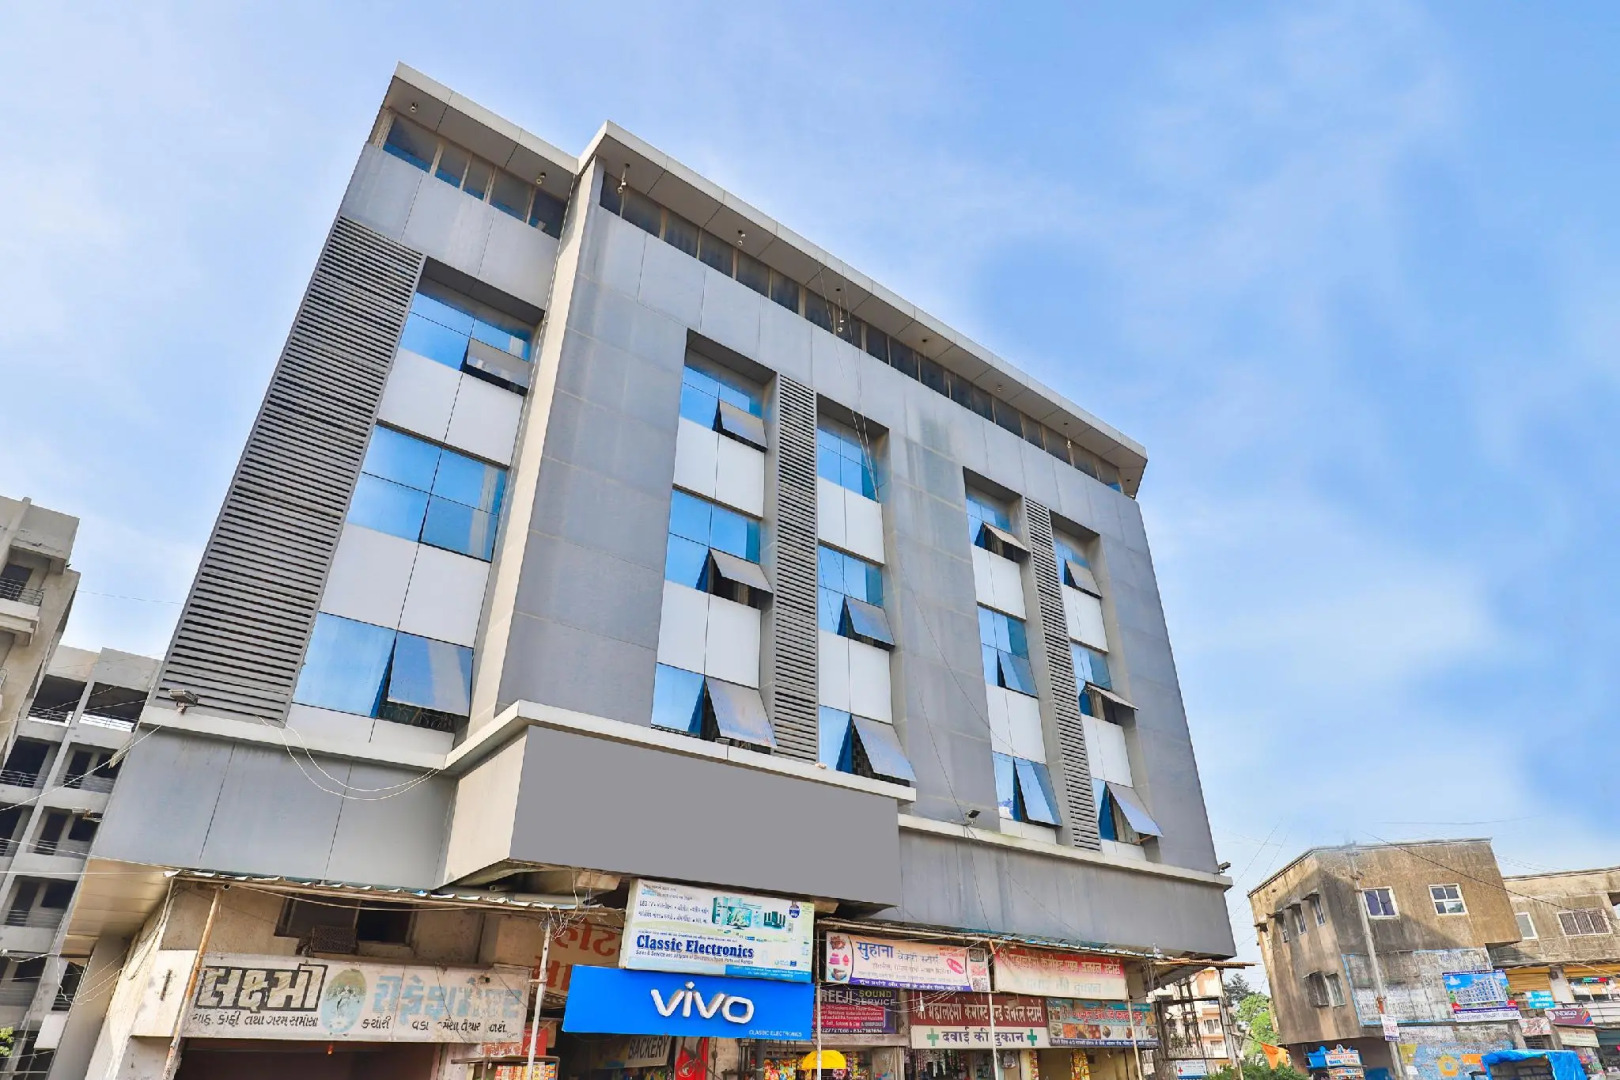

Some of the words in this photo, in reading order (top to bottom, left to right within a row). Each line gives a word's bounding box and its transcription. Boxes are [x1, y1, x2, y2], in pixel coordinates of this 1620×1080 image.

[636, 934, 683, 952] Classic
[685, 939, 755, 959] Electronics
[856, 941, 894, 961] सुहाना
[195, 963, 328, 1013] લક્ષ્મી
[820, 989, 853, 1004] REEJI
[860, 989, 892, 998] SOUND
[650, 981, 755, 1024] vivo
[855, 998, 897, 1006] SERVICE
[244, 1014, 264, 1026] તથા
[266, 1015, 288, 1027] ગરમ
[411, 1020, 429, 1032] વડા
[749, 1029, 769, 1037] CLASSIC
[941, 1026, 970, 1044] दवाई
[973, 1027, 990, 1043] की
[993, 1032, 1025, 1047] दुकान
[627, 1034, 670, 1060] BACKERY
